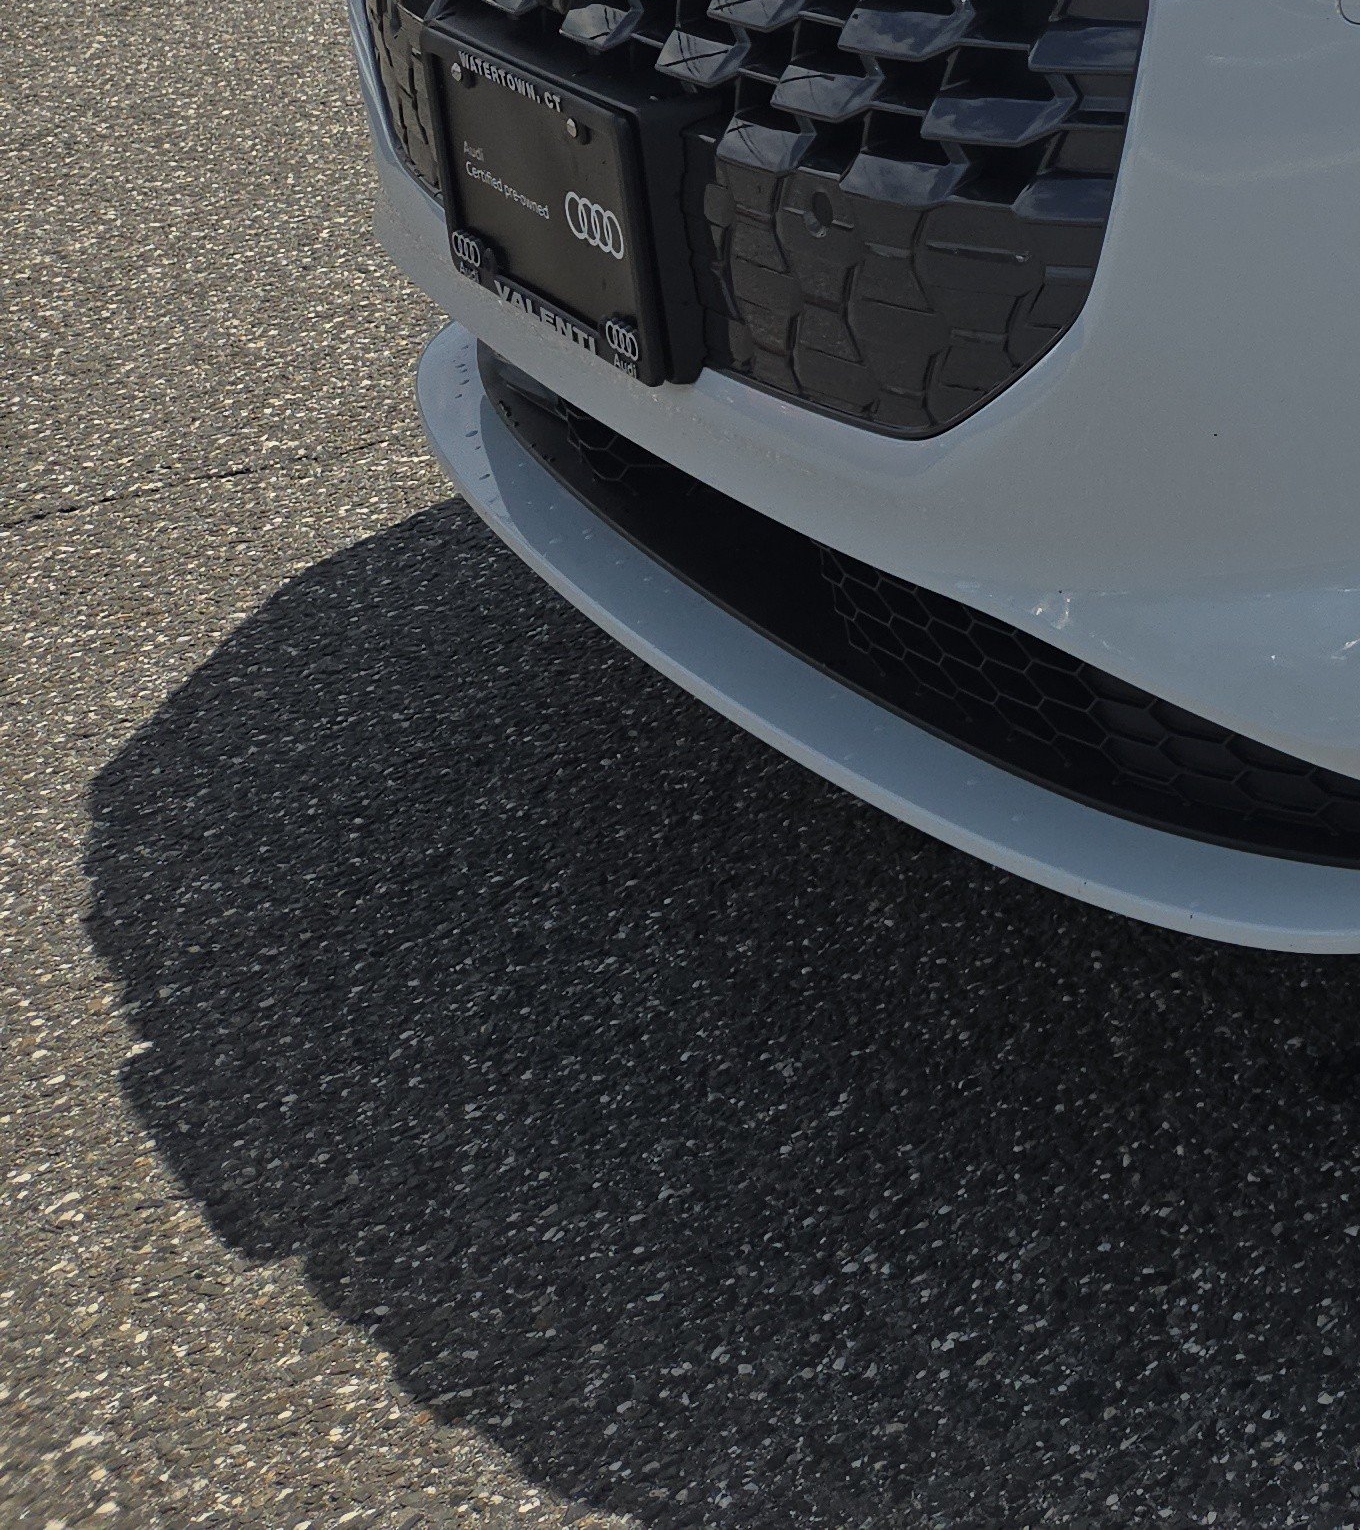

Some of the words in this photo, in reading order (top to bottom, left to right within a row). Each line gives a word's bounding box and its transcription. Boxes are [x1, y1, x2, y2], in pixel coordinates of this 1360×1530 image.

[458, 50, 541, 104] WATERTOWN,
[543, 91, 561, 113] CT
[465, 161, 504, 192] Certified
[504, 184, 550, 220] pre-owned
[494, 279, 599, 355] VALENTI
[613, 353, 638, 379] Audi
